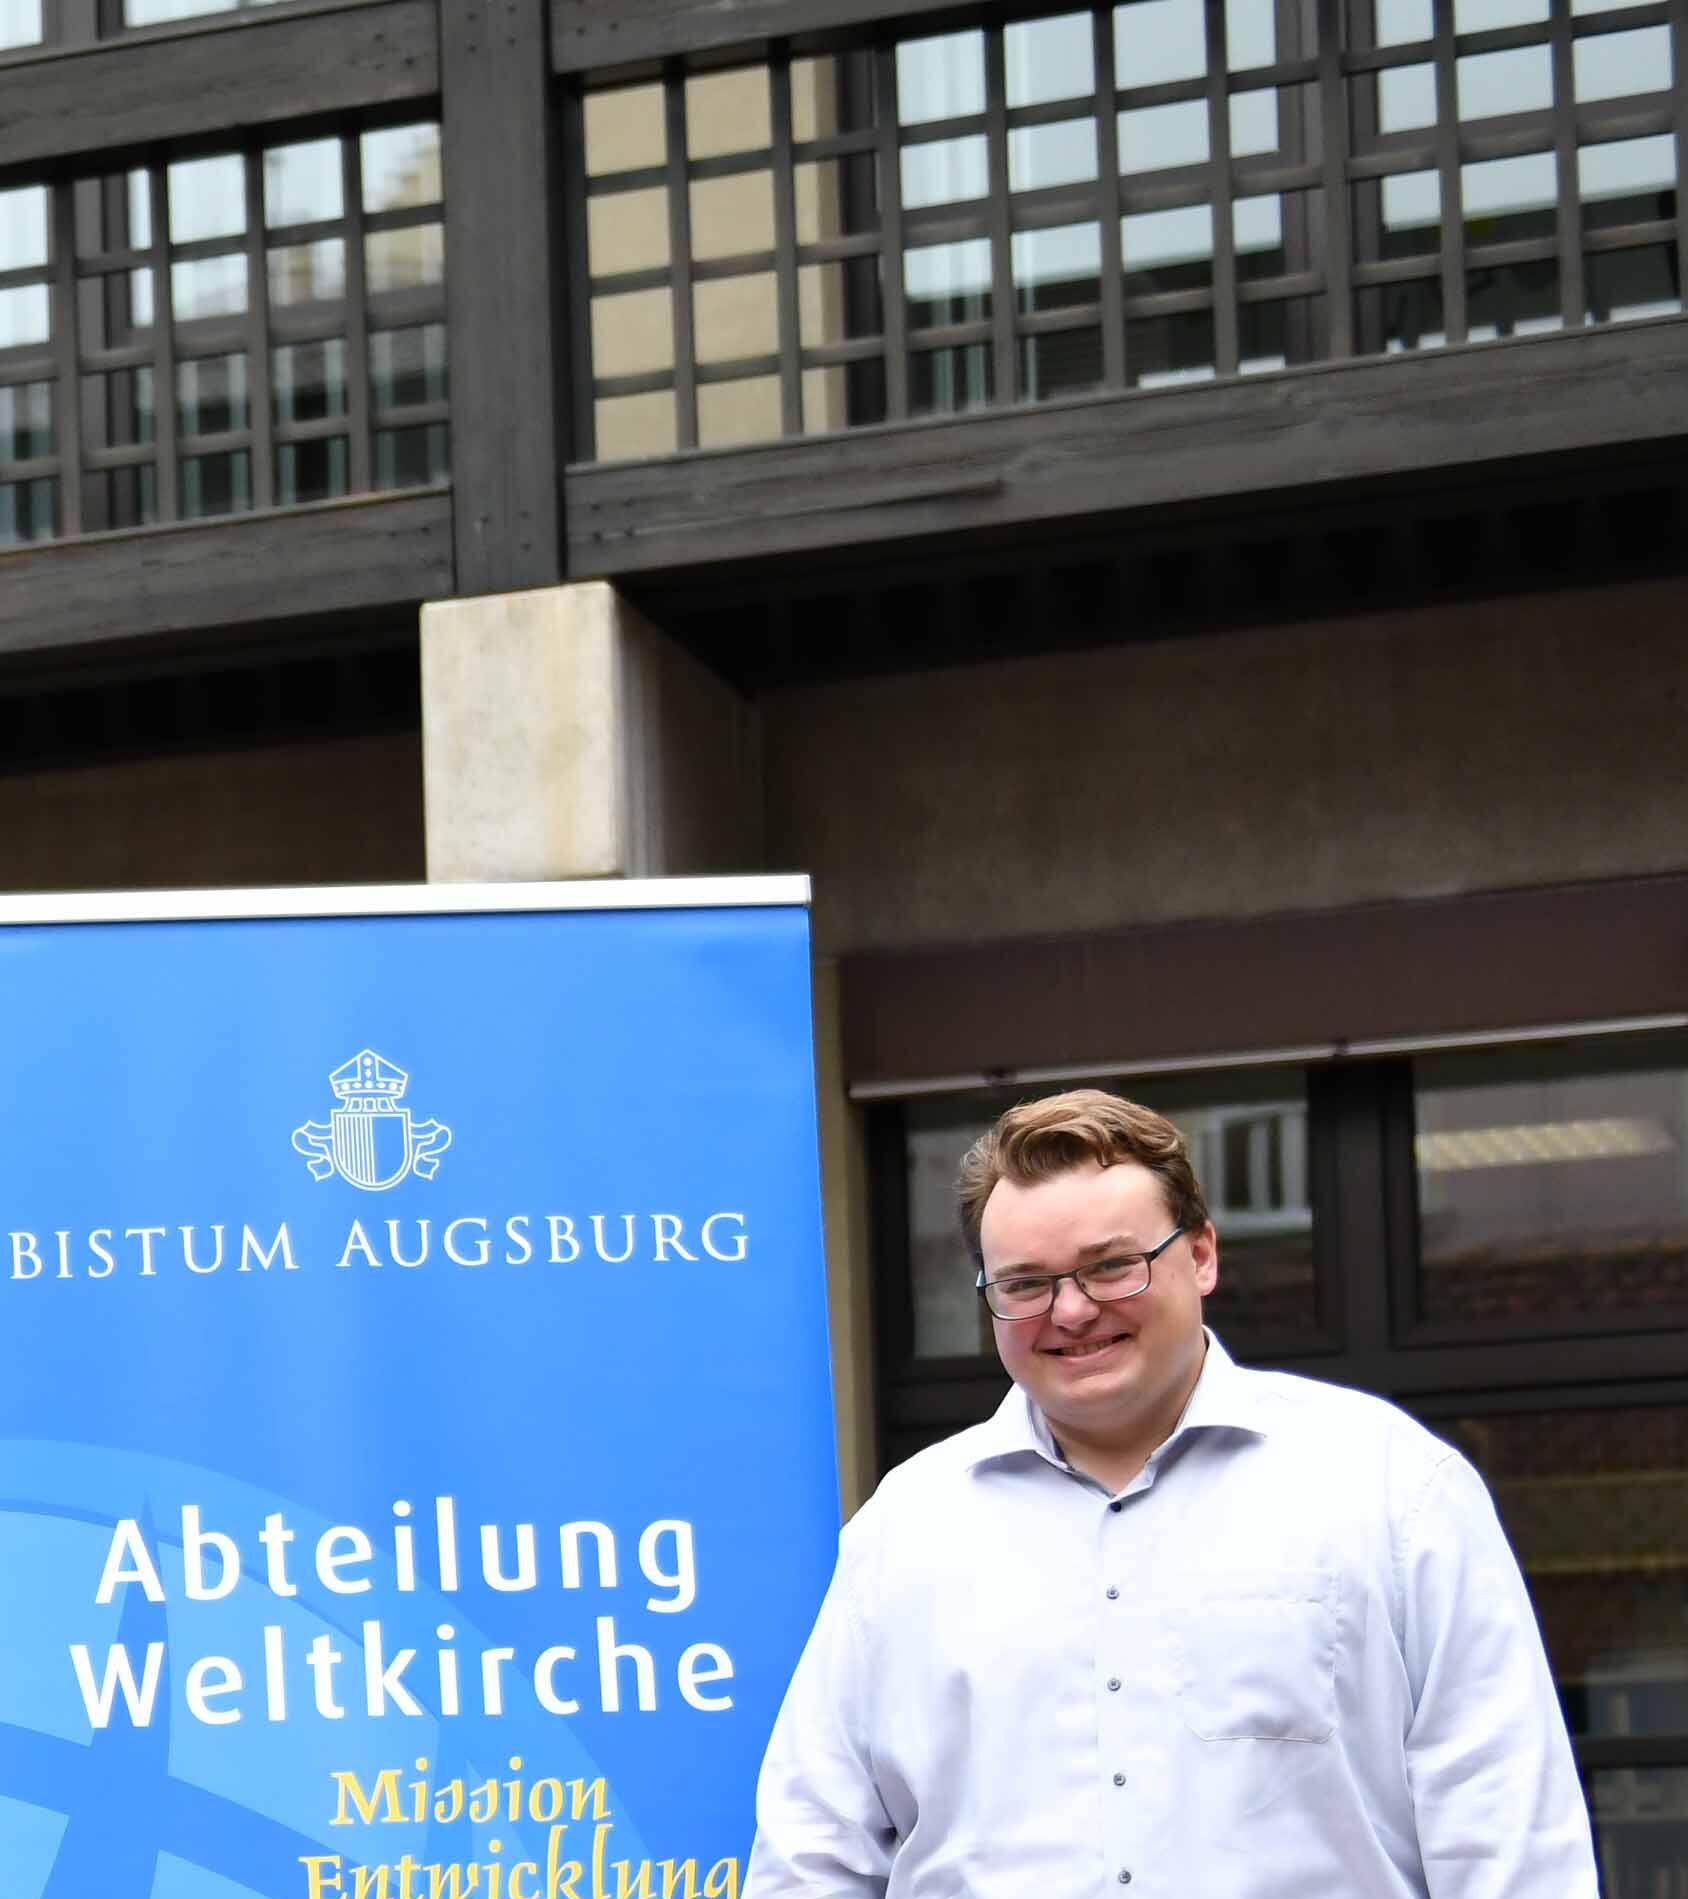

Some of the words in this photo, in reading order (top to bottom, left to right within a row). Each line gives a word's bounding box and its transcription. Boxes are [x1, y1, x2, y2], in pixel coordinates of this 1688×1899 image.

[10, 1222, 299, 1280] BISTUM
[335, 1212, 749, 1269] AUGSBURG
[94, 1492, 698, 1613] Abteilung
[68, 1616, 735, 1729] Weltkirche
[329, 1756, 612, 1826] Mission
